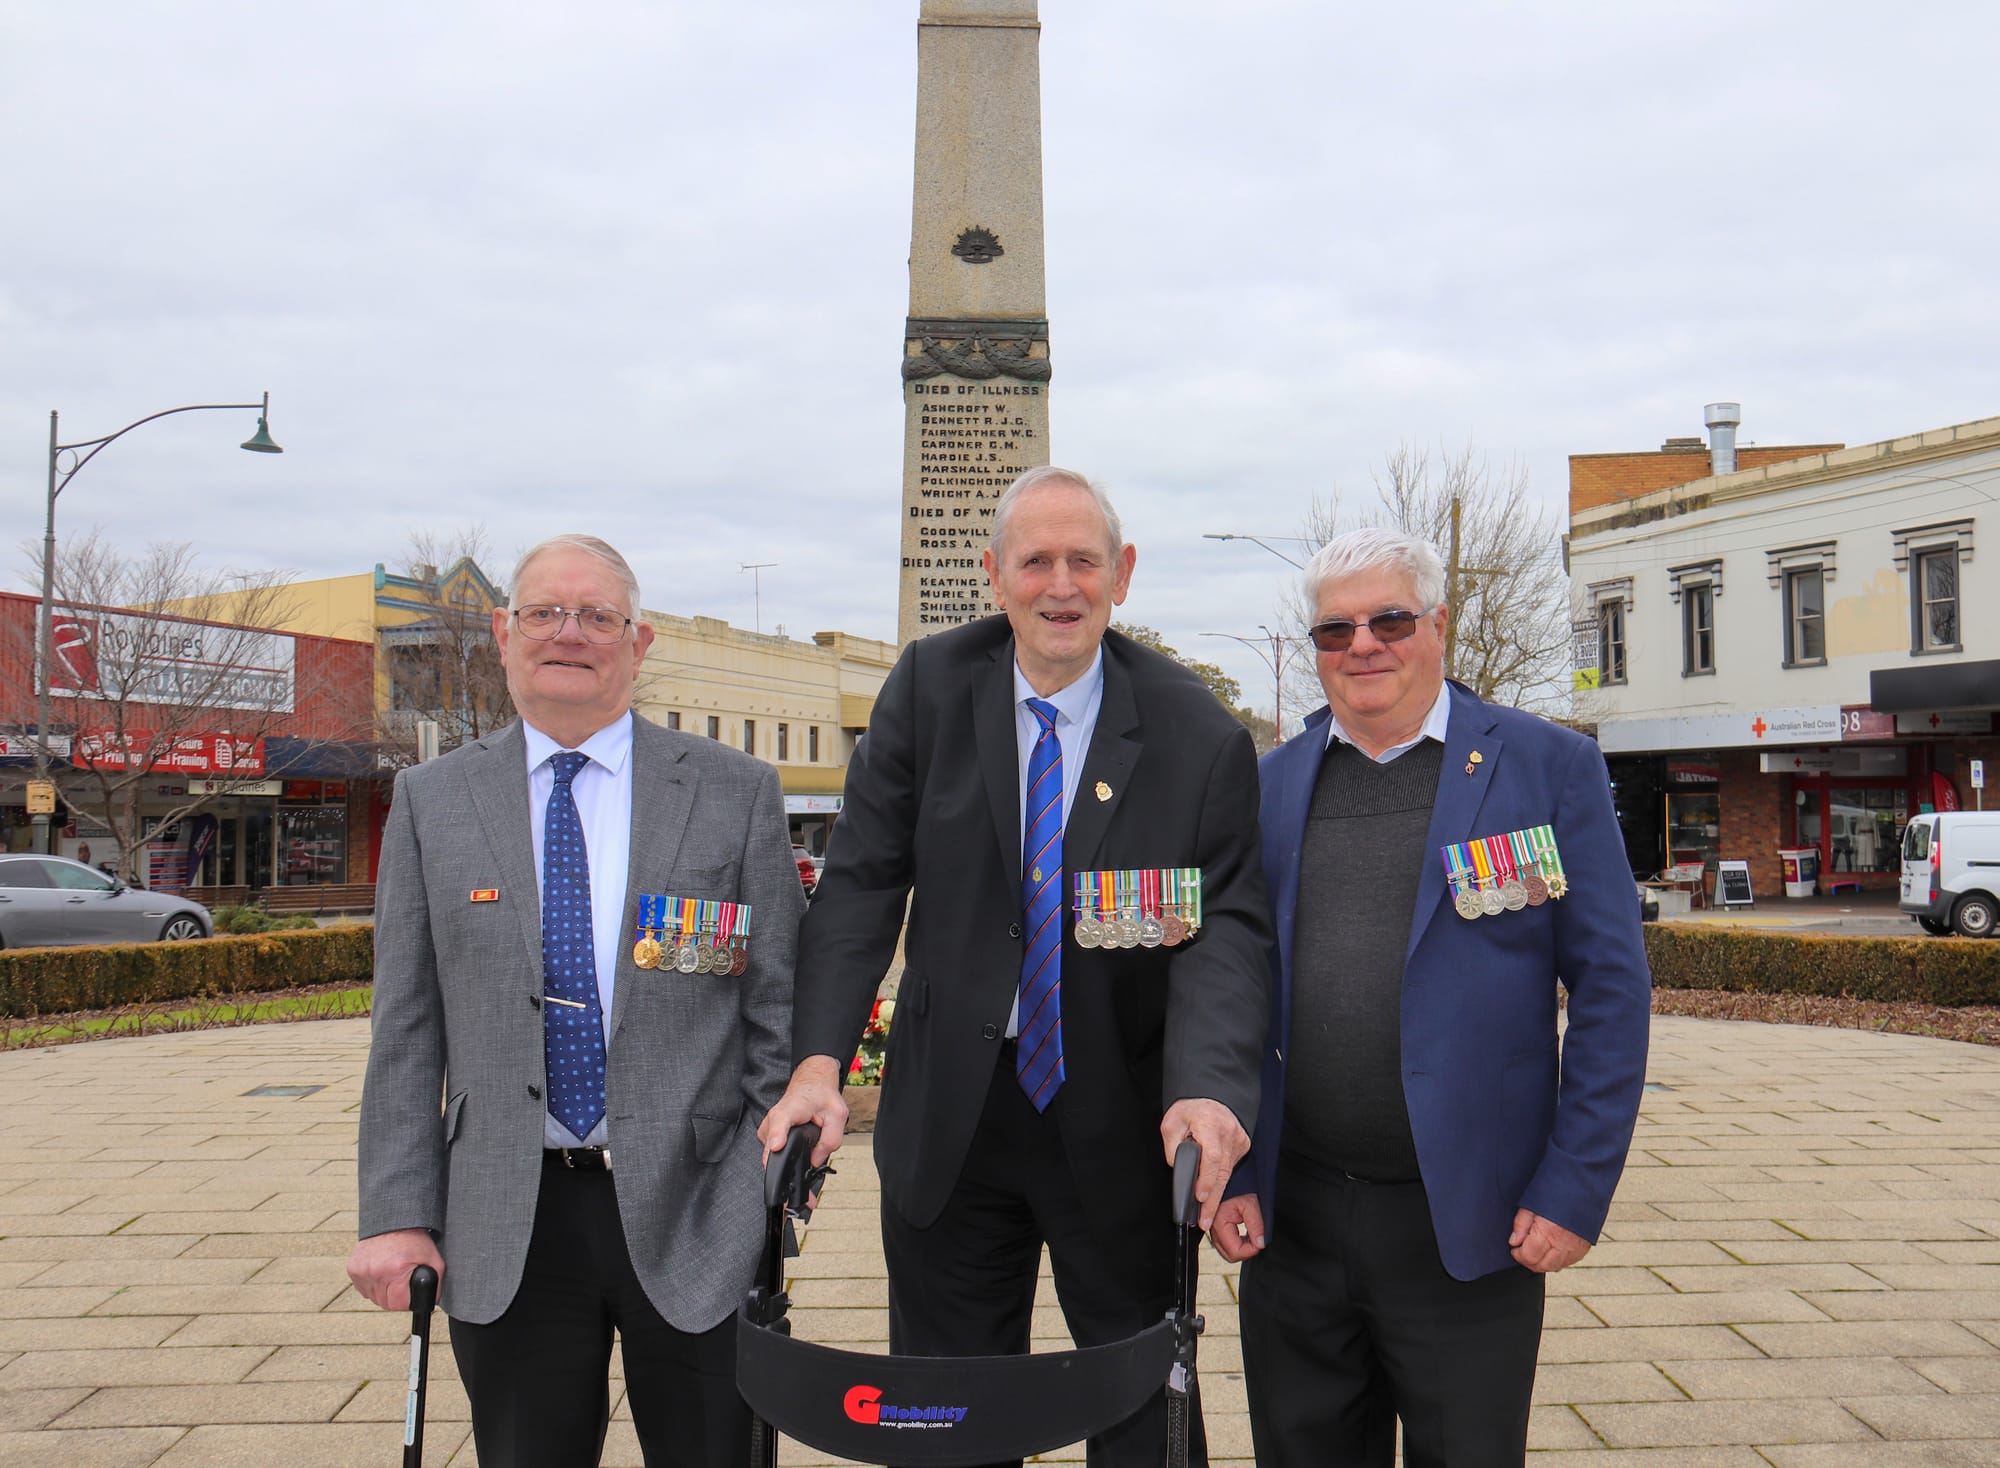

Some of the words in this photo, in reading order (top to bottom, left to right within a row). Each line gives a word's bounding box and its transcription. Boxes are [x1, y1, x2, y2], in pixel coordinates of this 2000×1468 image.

[915, 384, 950, 394] DIED
[958, 386, 975, 394] OF
[983, 386, 1040, 395] ILLNESS
[922, 404, 989, 412] ASHCROFT
[995, 405, 1010, 413] W.
[922, 416, 979, 424] BENNETT
[922, 428, 1006, 437] FAIRWEATHER
[922, 440, 982, 449] GARDNER
[921, 453, 970, 461] HARDIE
[975, 453, 1001, 461] J.S.
[921, 465, 990, 473] MARSHALL
[921, 489, 971, 498] WRIGHT
[910, 507, 944, 517] DIED
[953, 508, 970, 517] OF
[920, 527, 990, 536] GOODWILL
[920, 539, 957, 548] ROSS
[964, 540, 978, 548] A.
[903, 558, 931, 567] DIED
[936, 559, 974, 568] AFTER
[920, 578, 977, 586] KEATING
[920, 590, 964, 598] MURIE
[971, 590, 985, 598] R.
[920, 602, 976, 611] SHIELDS
[920, 614, 962, 623] SMITH
[1770, 722, 1801, 731] Australian
[1802, 720, 1816, 729] Red
[1817, 719, 1836, 728] Cross
[172, 753, 208, 769] Framing
[879, 1421, 953, 1430] www.gmobility.com.au
